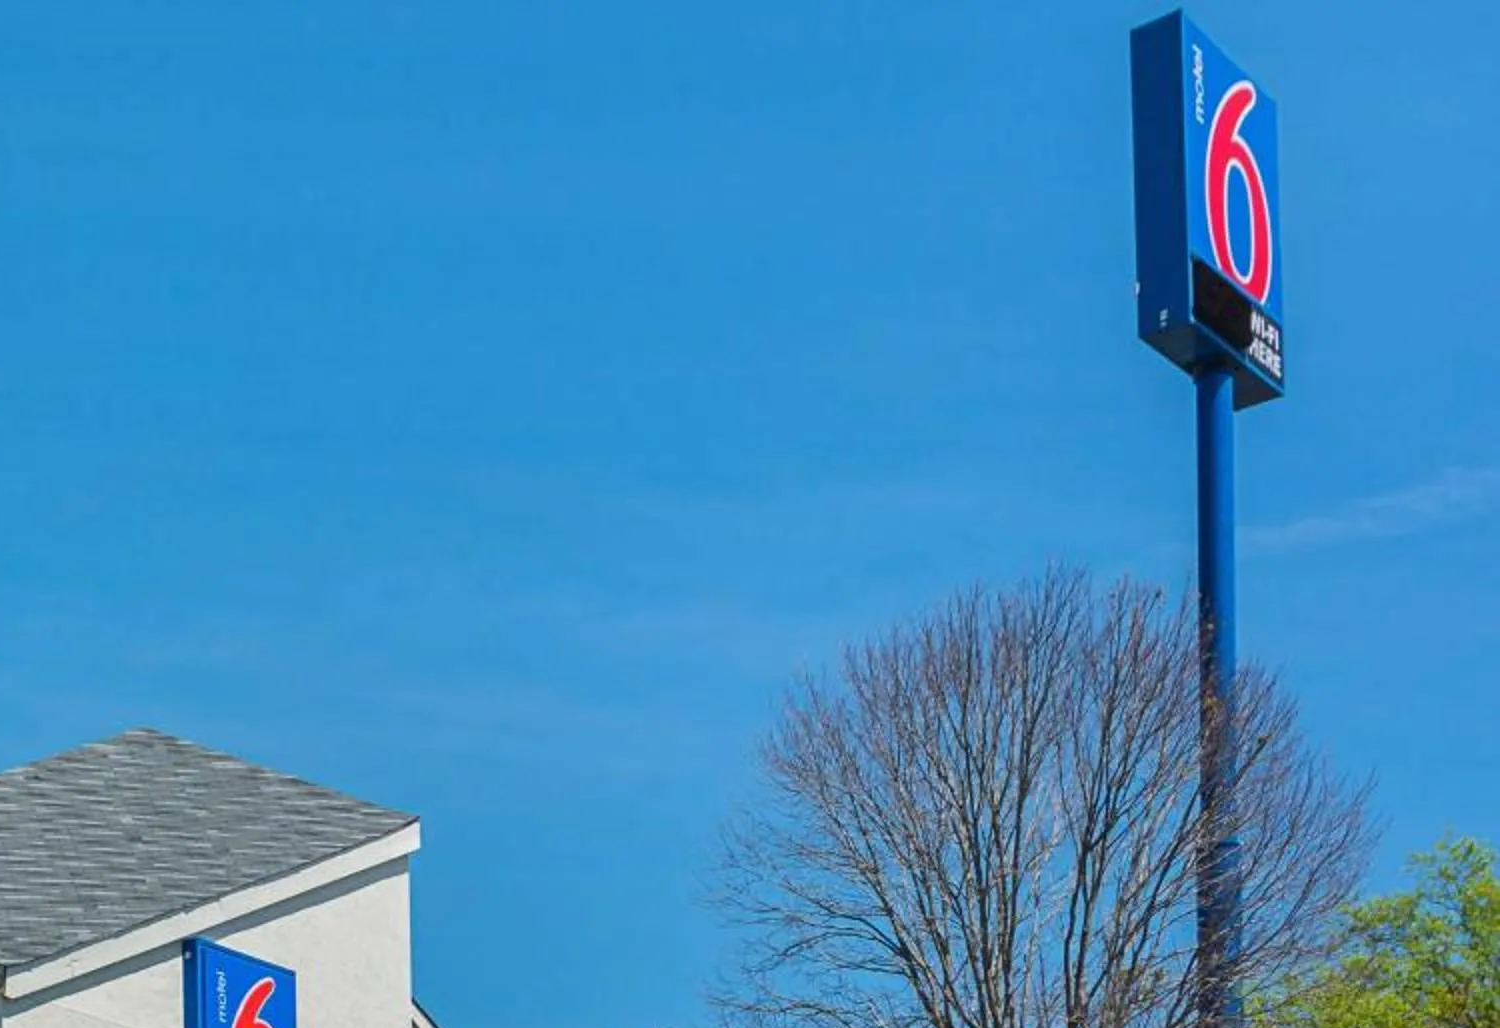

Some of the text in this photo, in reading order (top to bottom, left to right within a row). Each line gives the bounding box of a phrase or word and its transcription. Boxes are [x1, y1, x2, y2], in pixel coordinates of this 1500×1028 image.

[1192, 44, 1205, 124] motel
[1205, 80, 1272, 304] 6
[215, 970, 227, 1023] motel
